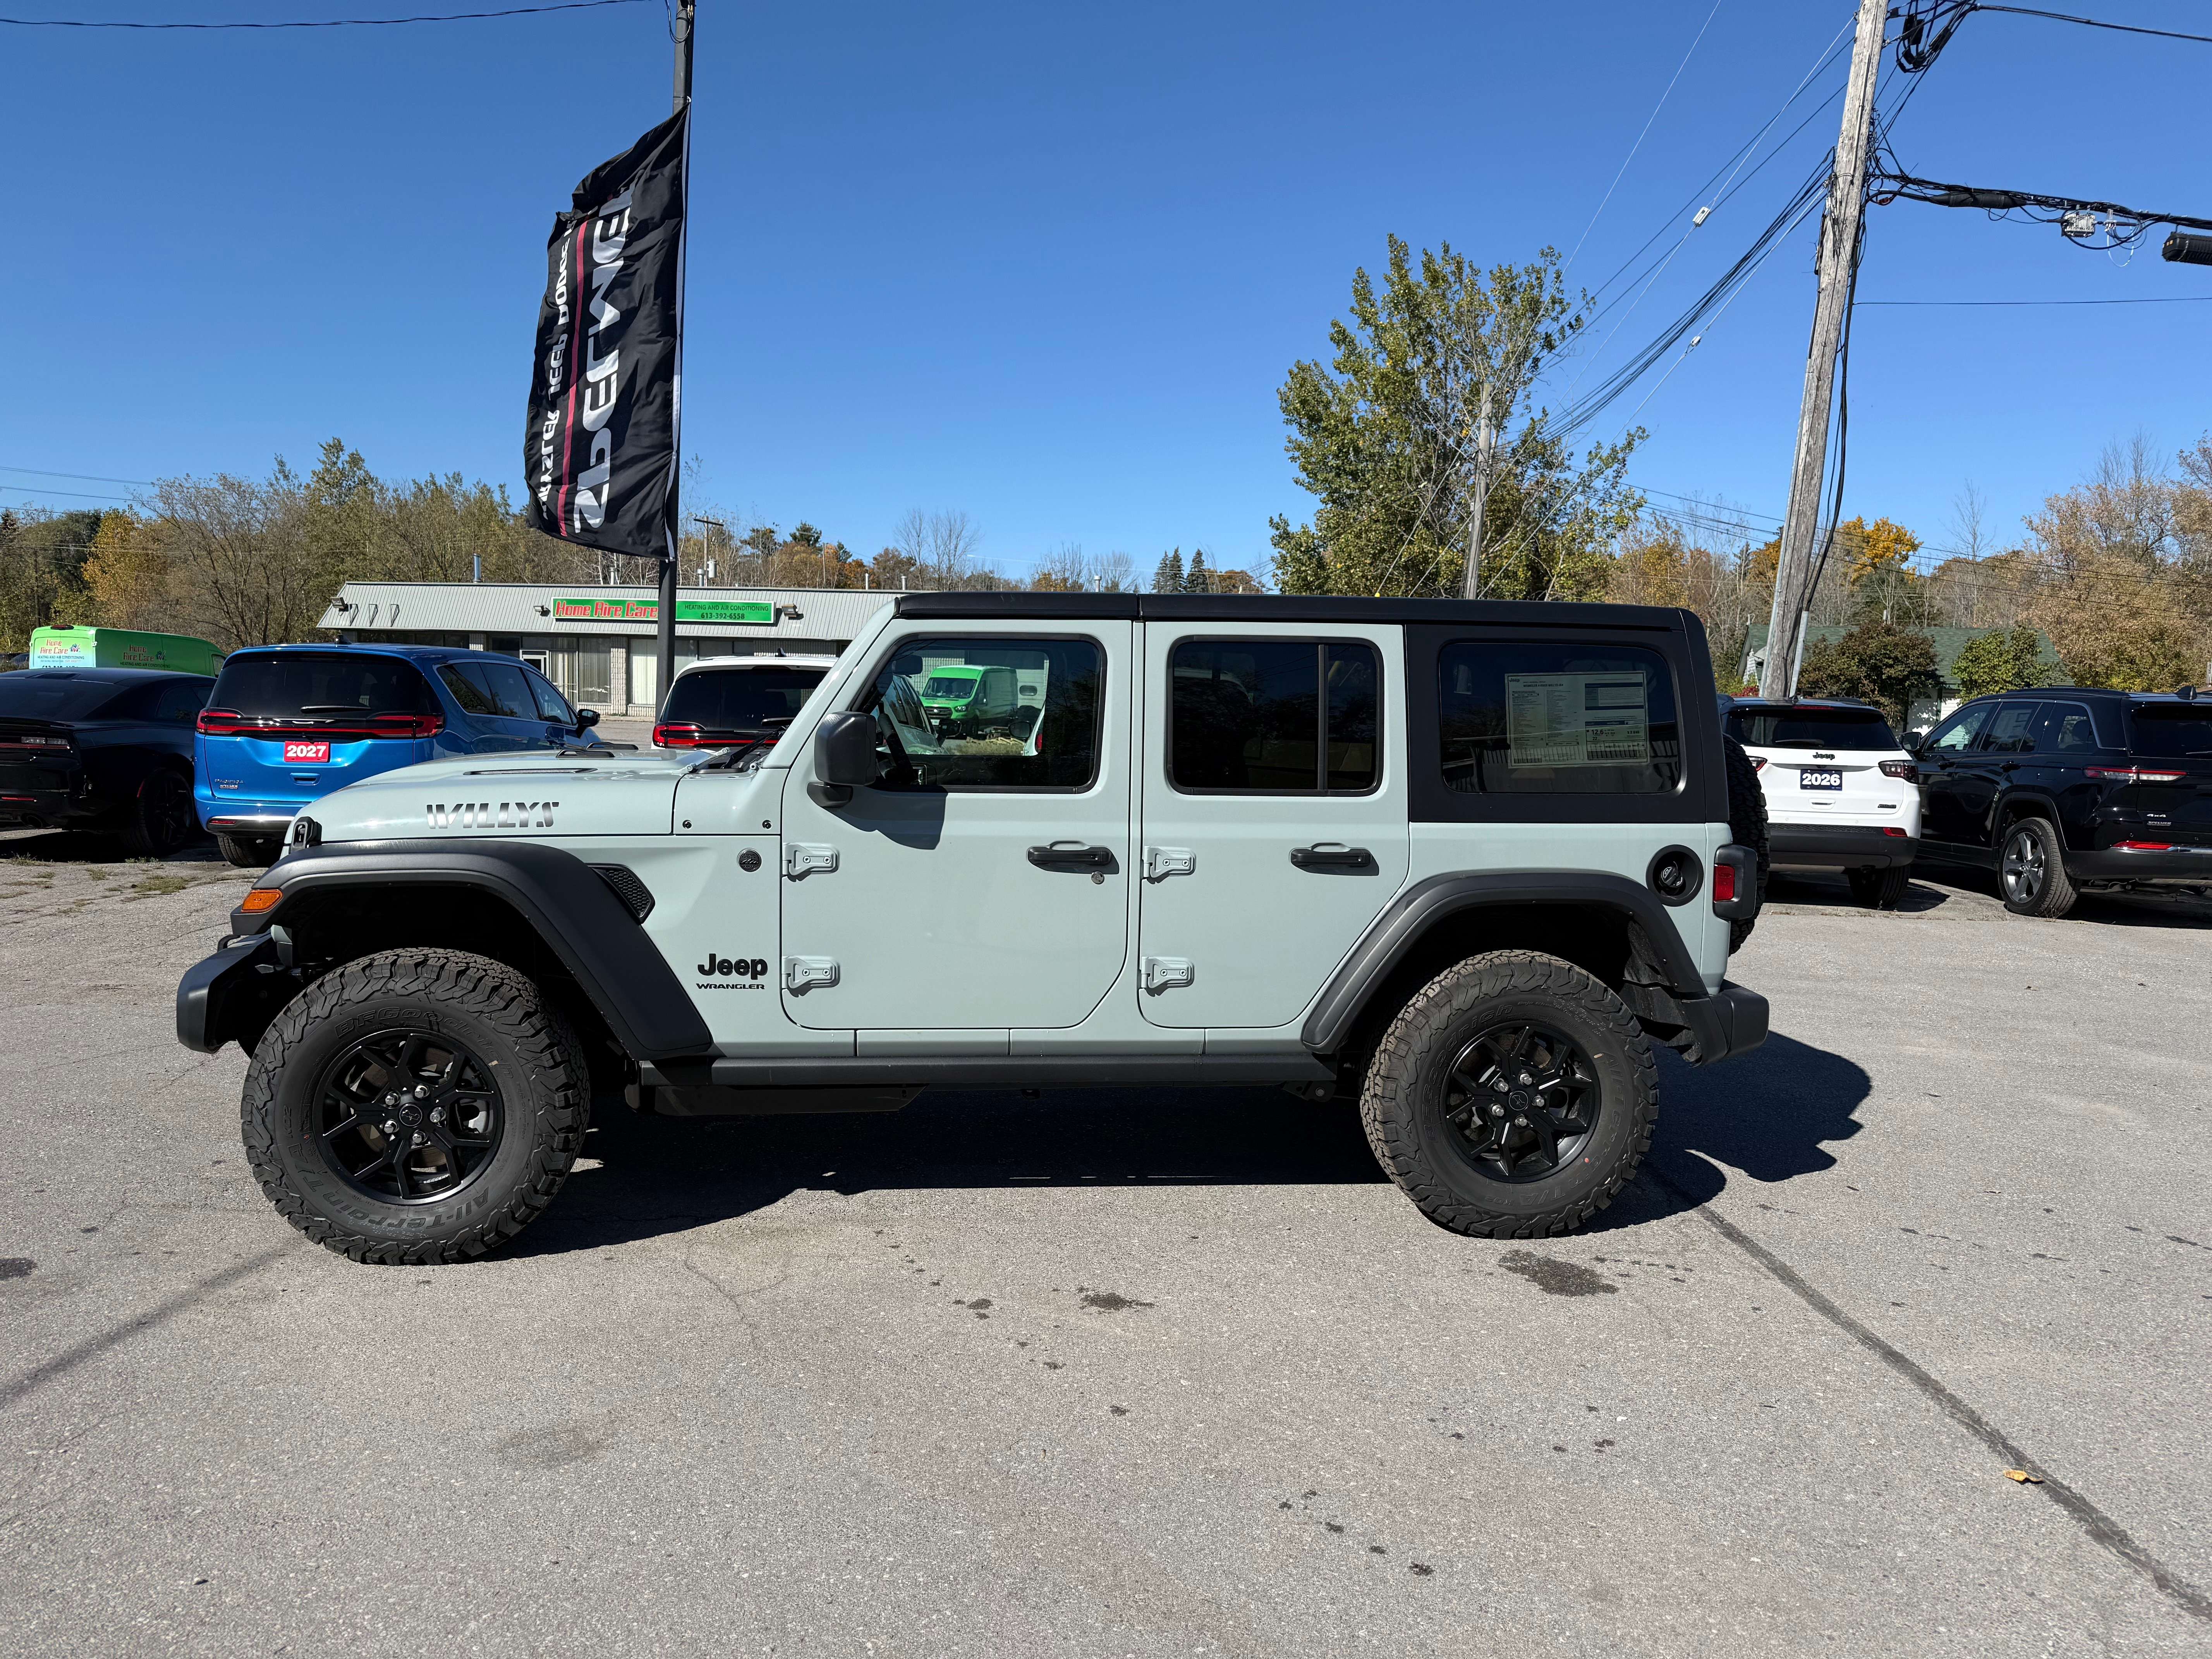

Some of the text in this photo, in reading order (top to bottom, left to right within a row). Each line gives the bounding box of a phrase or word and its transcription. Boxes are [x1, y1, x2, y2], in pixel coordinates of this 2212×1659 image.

[555, 601, 658, 618] Home Aire Care
[129, 644, 146, 653] Home
[139, 653, 155, 662] Care
[287, 745, 326, 757] 2027
[1812, 752, 1835, 761] Jeep
[1802, 773, 1840, 786] 2026
[426, 802, 559, 829] WILLYS
[697, 953, 768, 980] Jeep
[334, 1006, 515, 1079] BFGoodrich
[1423, 1004, 1513, 1142] BFGoodrich
